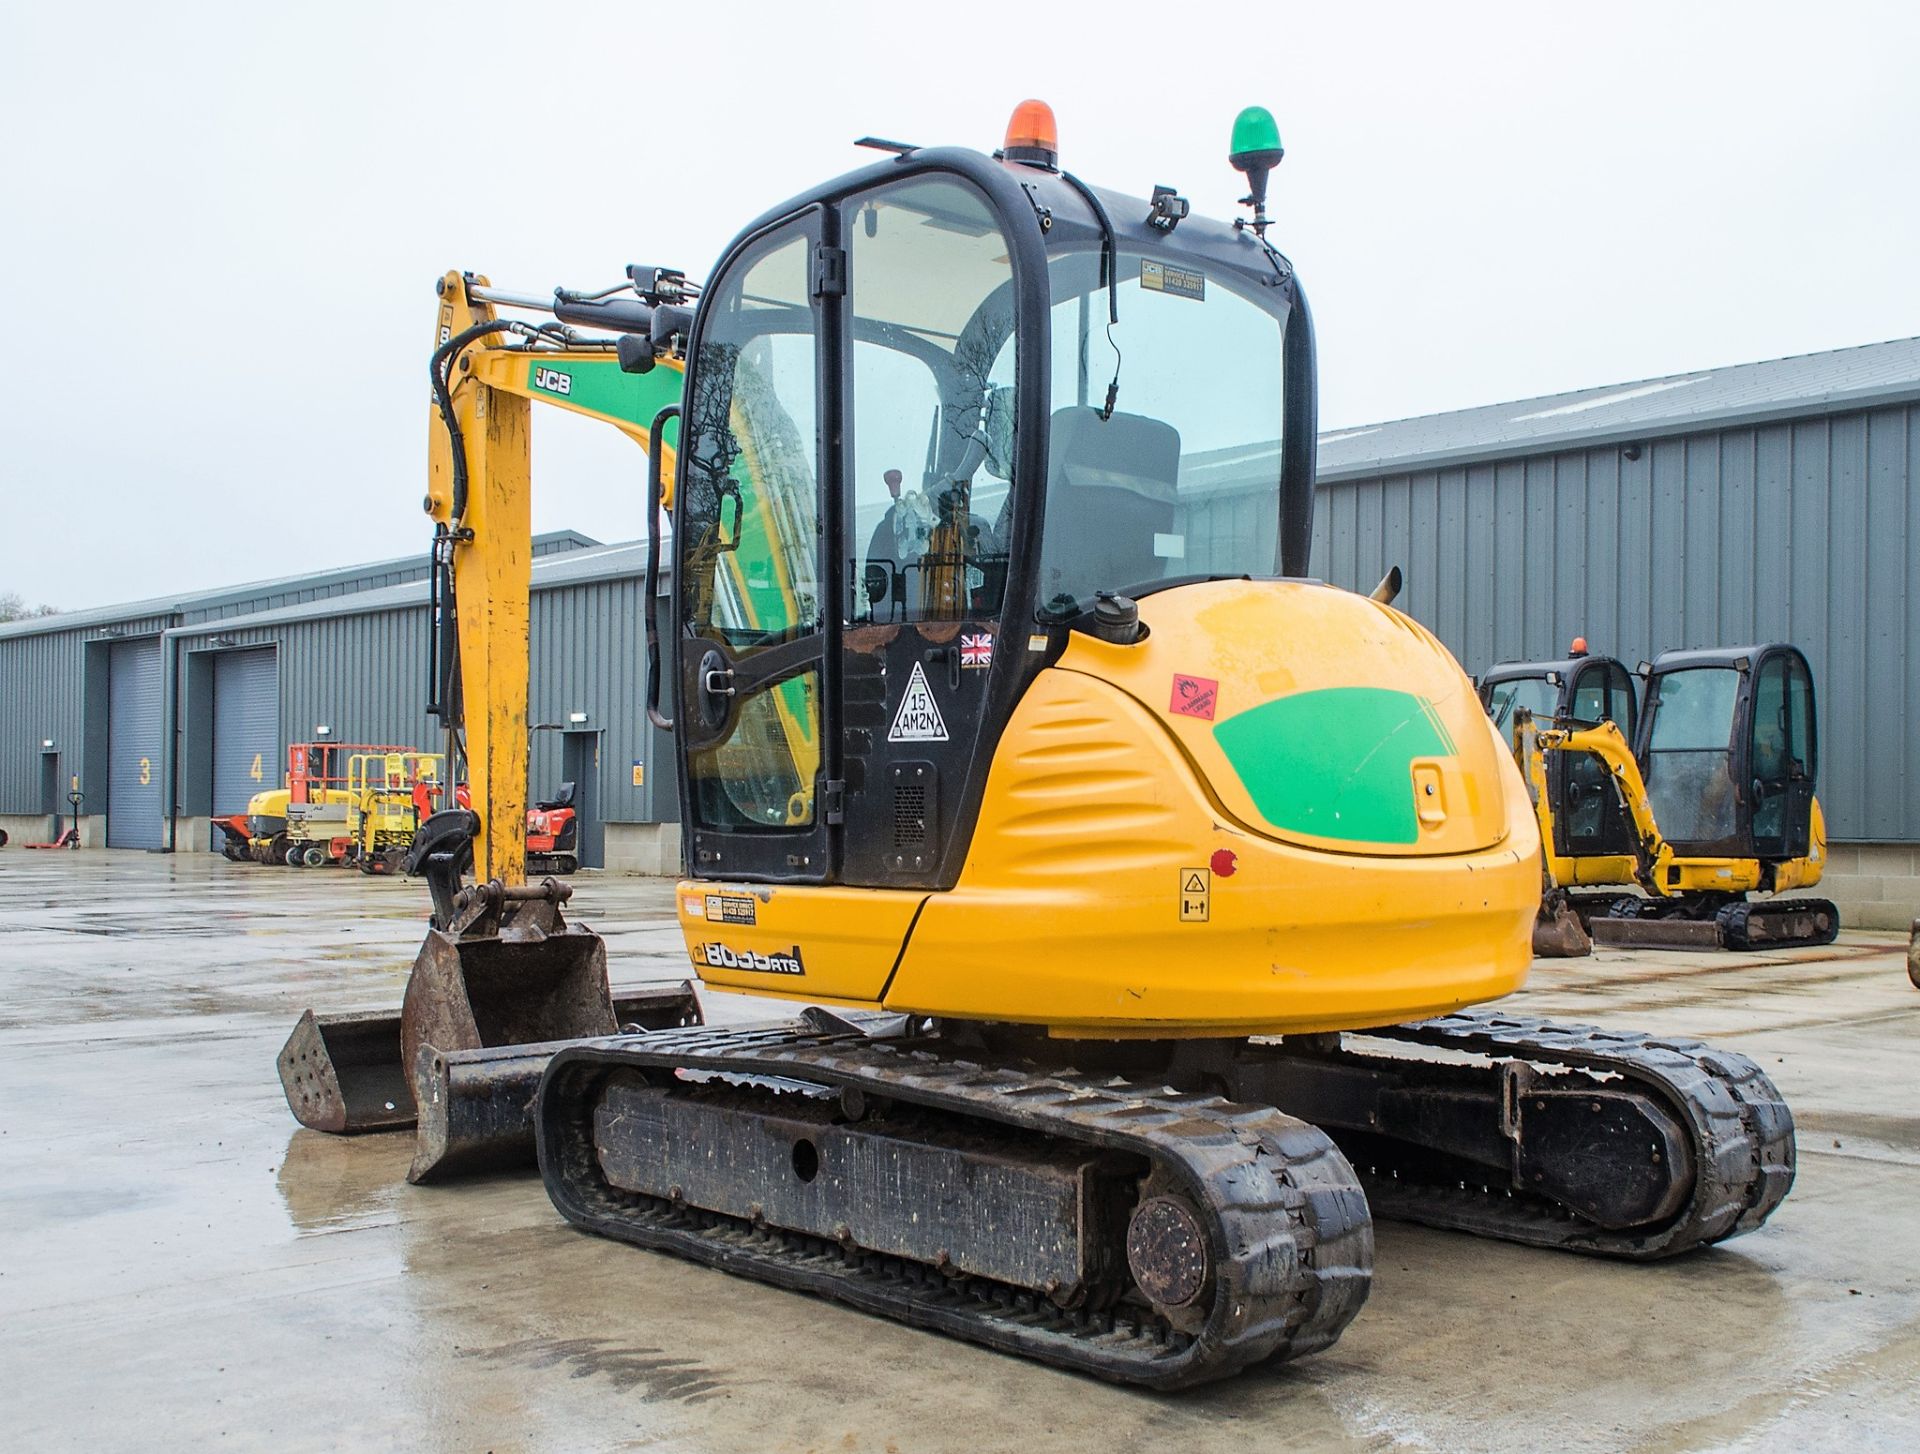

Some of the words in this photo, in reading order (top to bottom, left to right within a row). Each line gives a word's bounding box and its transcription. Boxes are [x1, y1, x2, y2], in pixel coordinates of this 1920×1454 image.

[535, 369, 571, 394] JCB
[911, 693, 926, 711] 15
[1181, 690, 1214, 712] FLAMMABLE
[903, 712, 935, 731] AM2N
[139, 757, 151, 785] 3
[249, 753, 263, 783] 4
